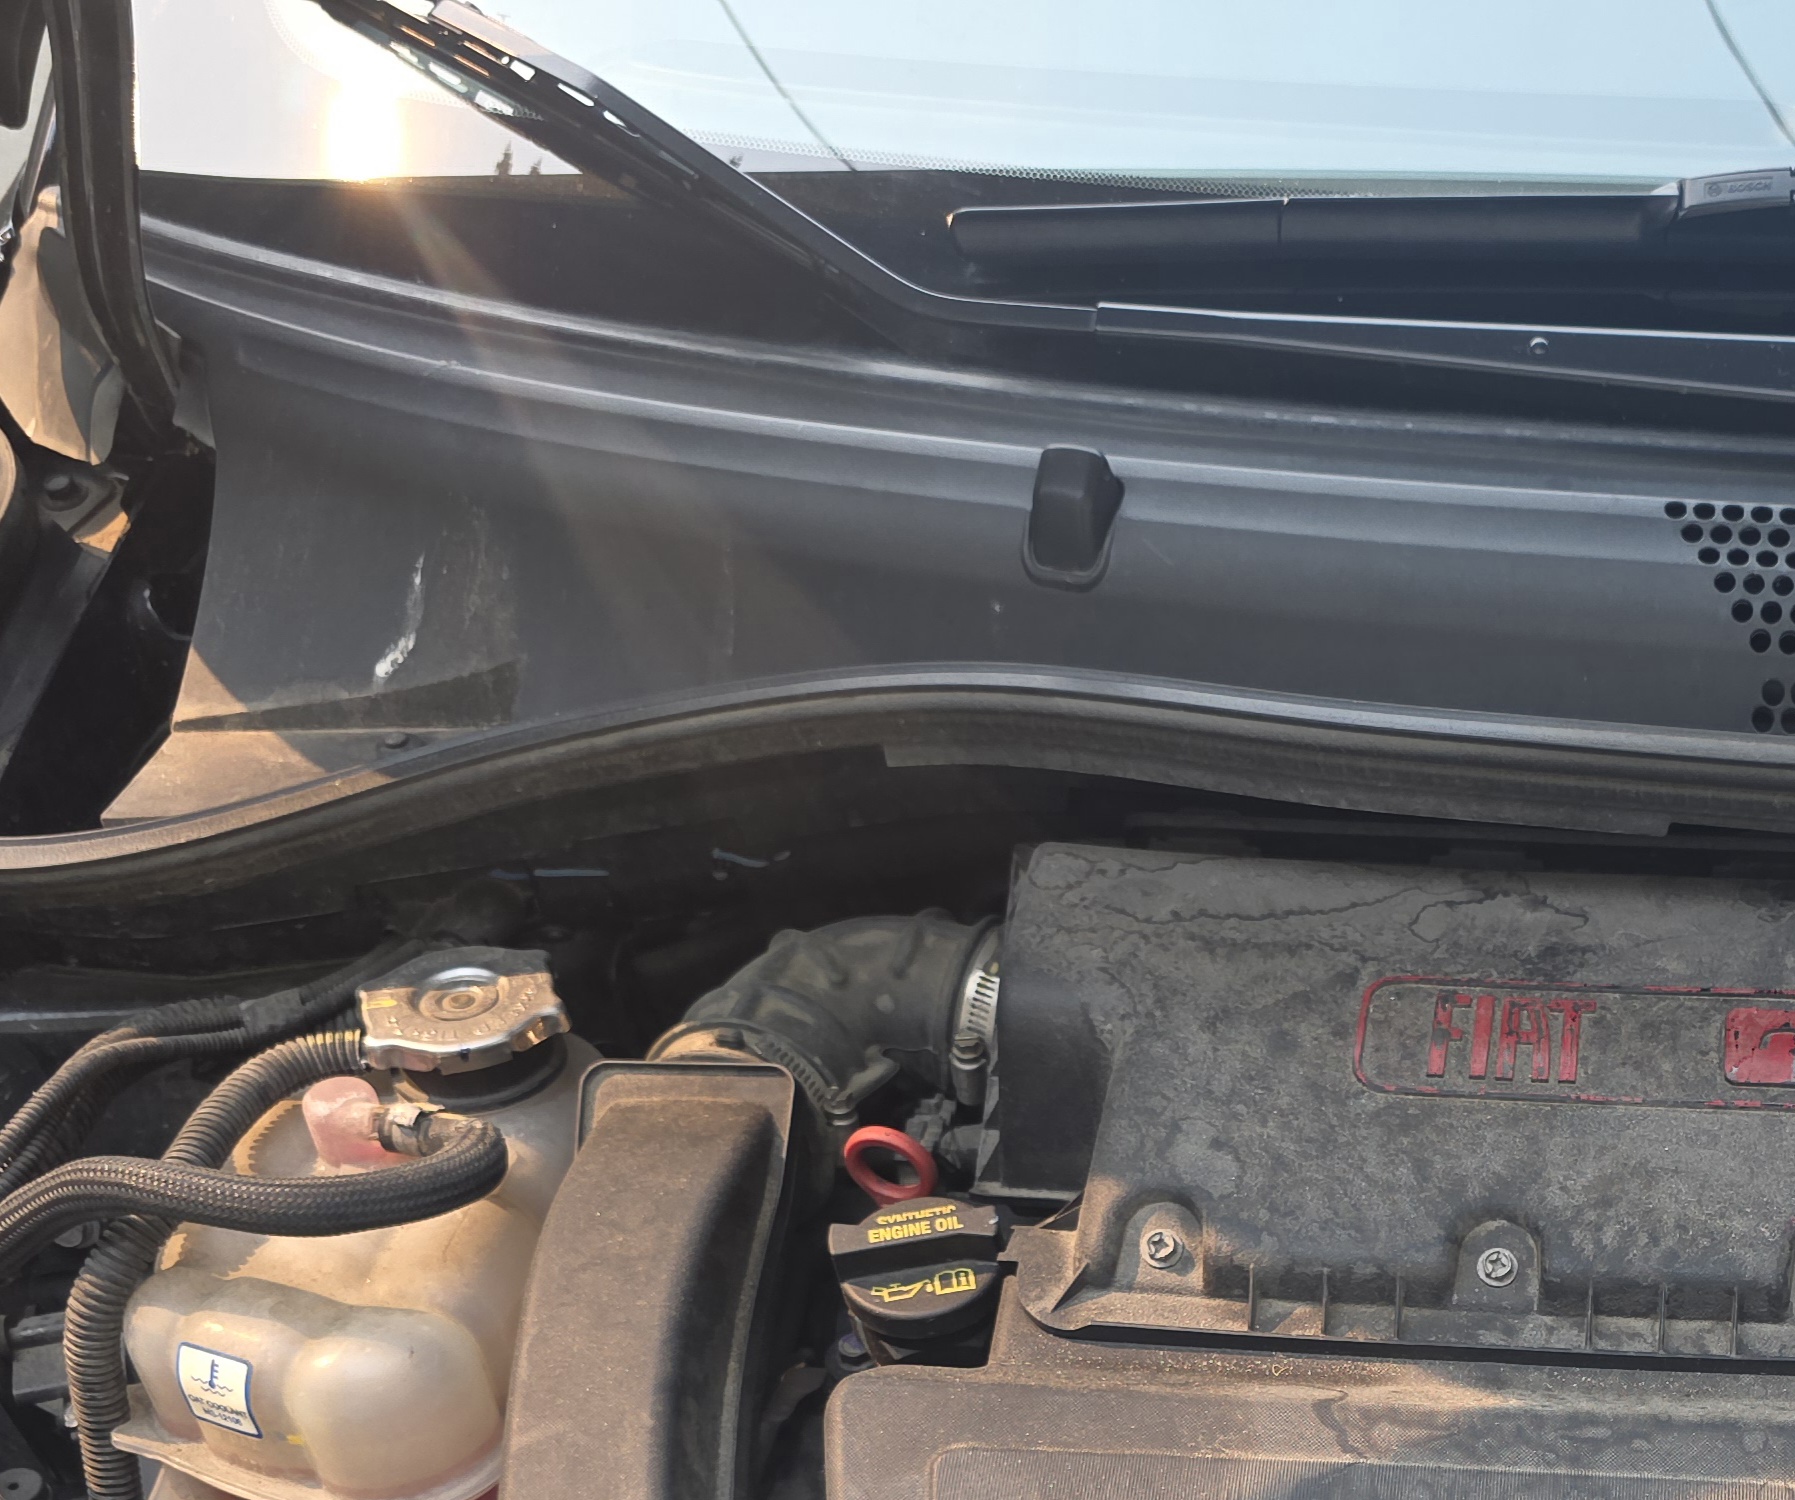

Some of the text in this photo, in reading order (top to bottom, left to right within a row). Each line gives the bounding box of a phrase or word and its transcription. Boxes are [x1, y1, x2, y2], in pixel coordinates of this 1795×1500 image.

[1426, 990, 1597, 1084] FIAT
[867, 1216, 965, 1244] ENGINE OIL
